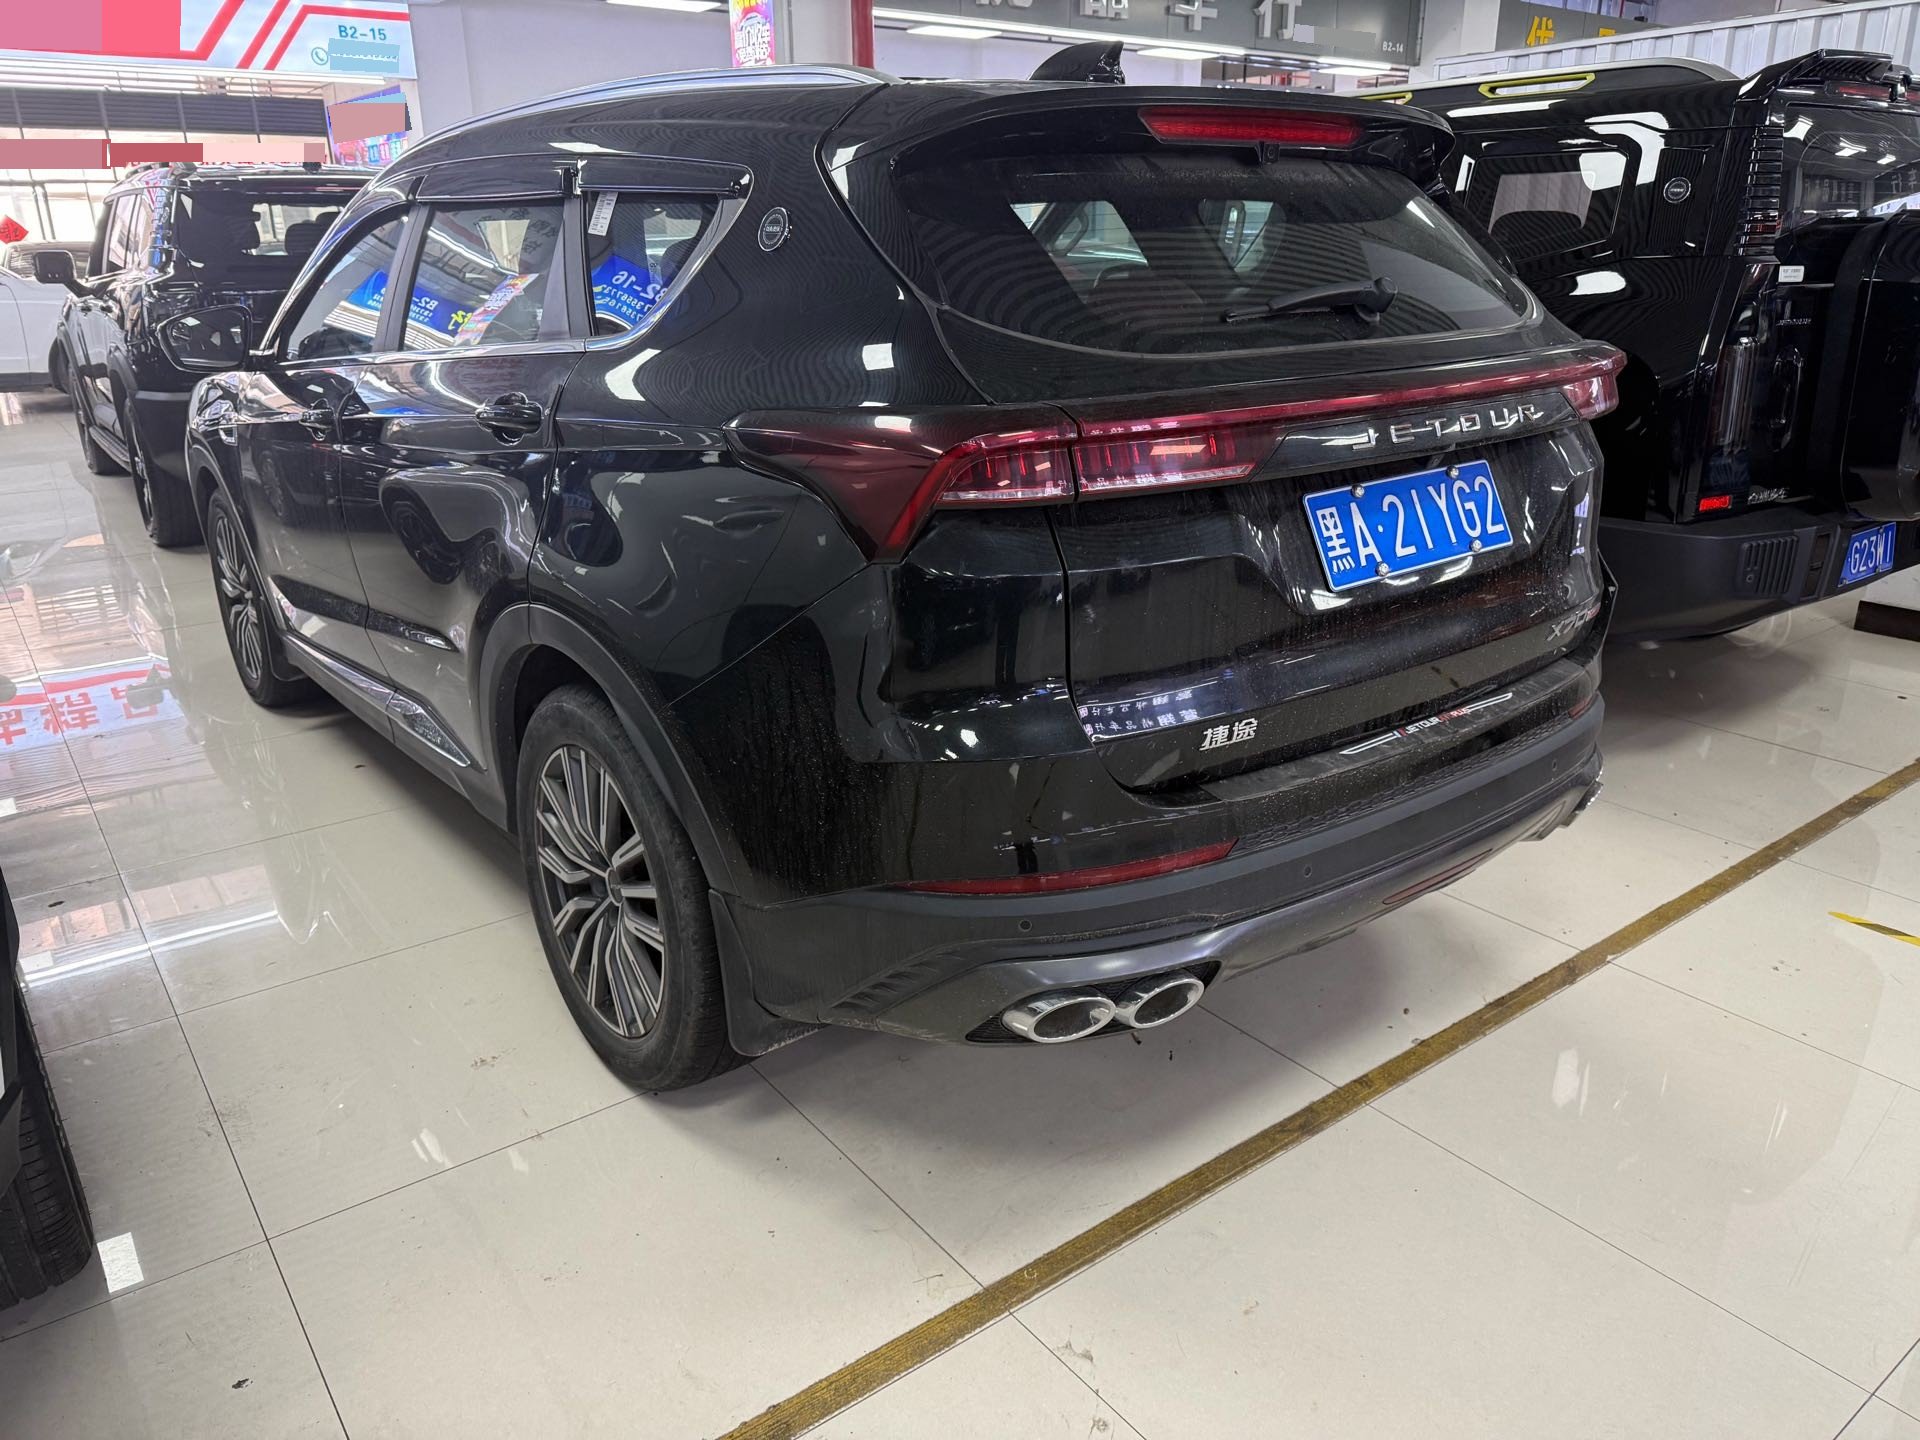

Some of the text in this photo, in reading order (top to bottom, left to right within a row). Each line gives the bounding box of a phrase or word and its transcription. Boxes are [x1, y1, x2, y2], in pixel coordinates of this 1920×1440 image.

[338, 24, 386, 41] B2-15
[1382, 41, 1404, 53] B2-14
[1352, 404, 1536, 450] JETOUR
[1200, 717, 1258, 751] 捷途
